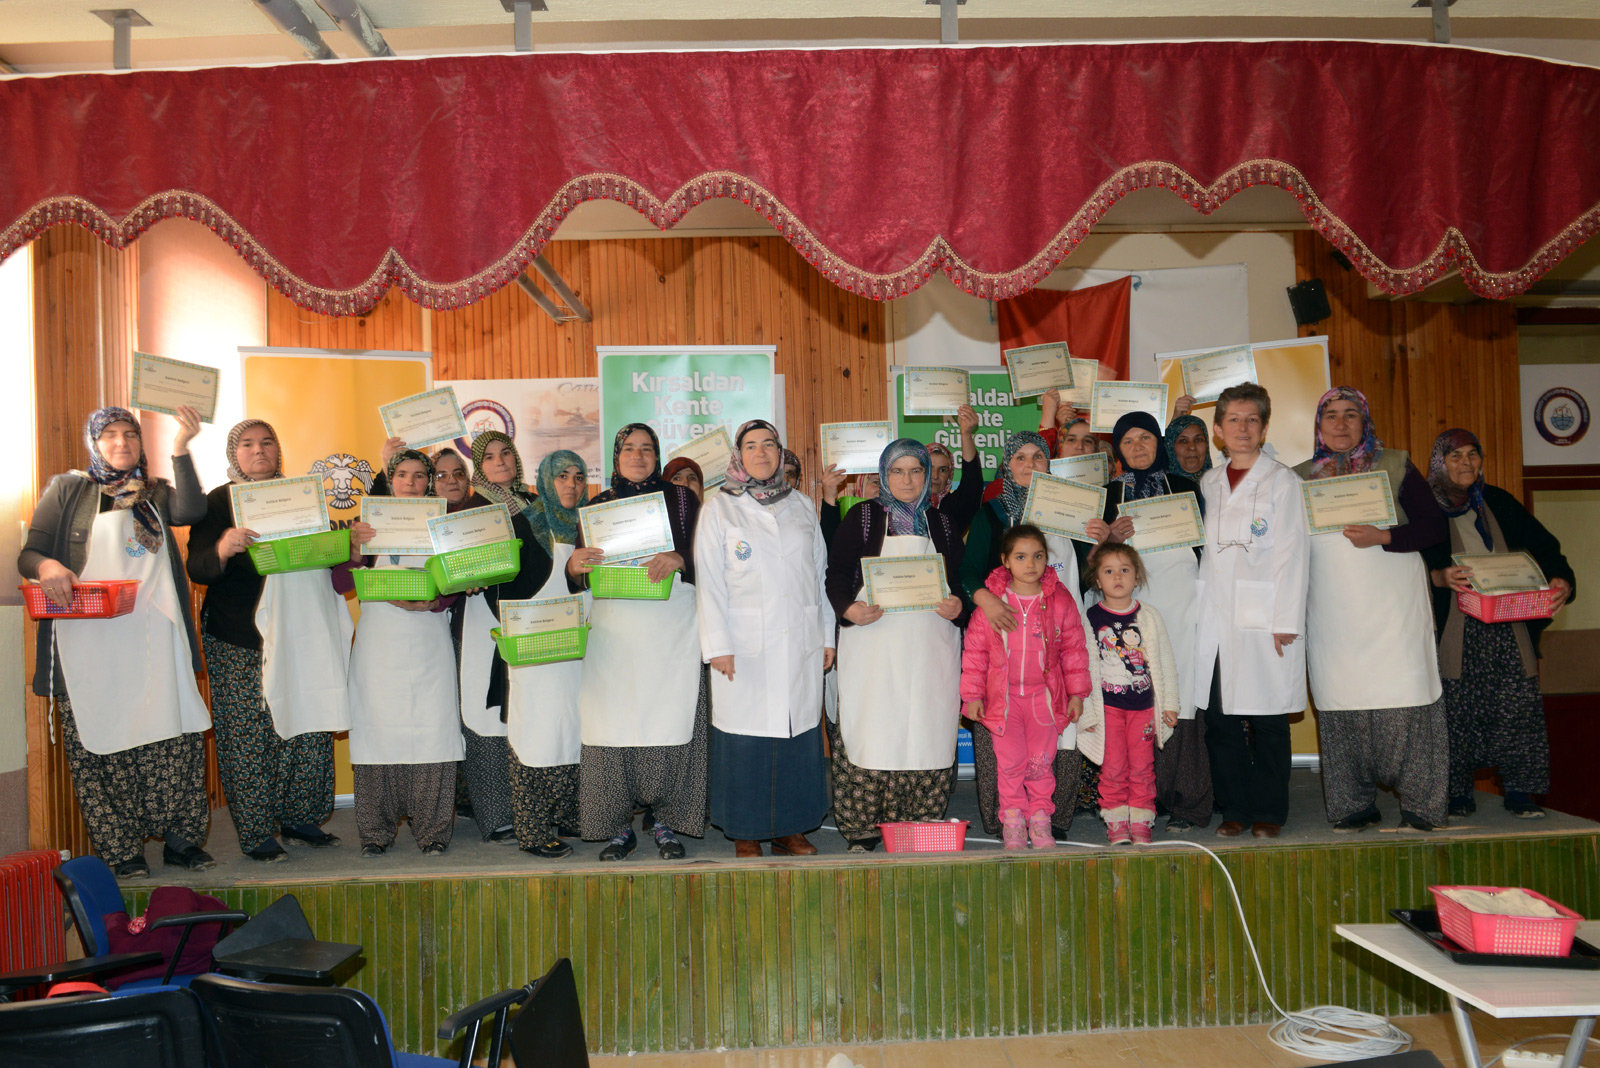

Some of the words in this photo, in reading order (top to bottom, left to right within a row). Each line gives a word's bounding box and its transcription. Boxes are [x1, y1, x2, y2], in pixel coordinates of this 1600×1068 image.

[632, 371, 744, 392] Kırsaldan
[654, 396, 722, 416] Kente
[943, 411, 1004, 428] Knte
[934, 429, 1012, 448] Güenl
[1101, 680, 1128, 694] appy
